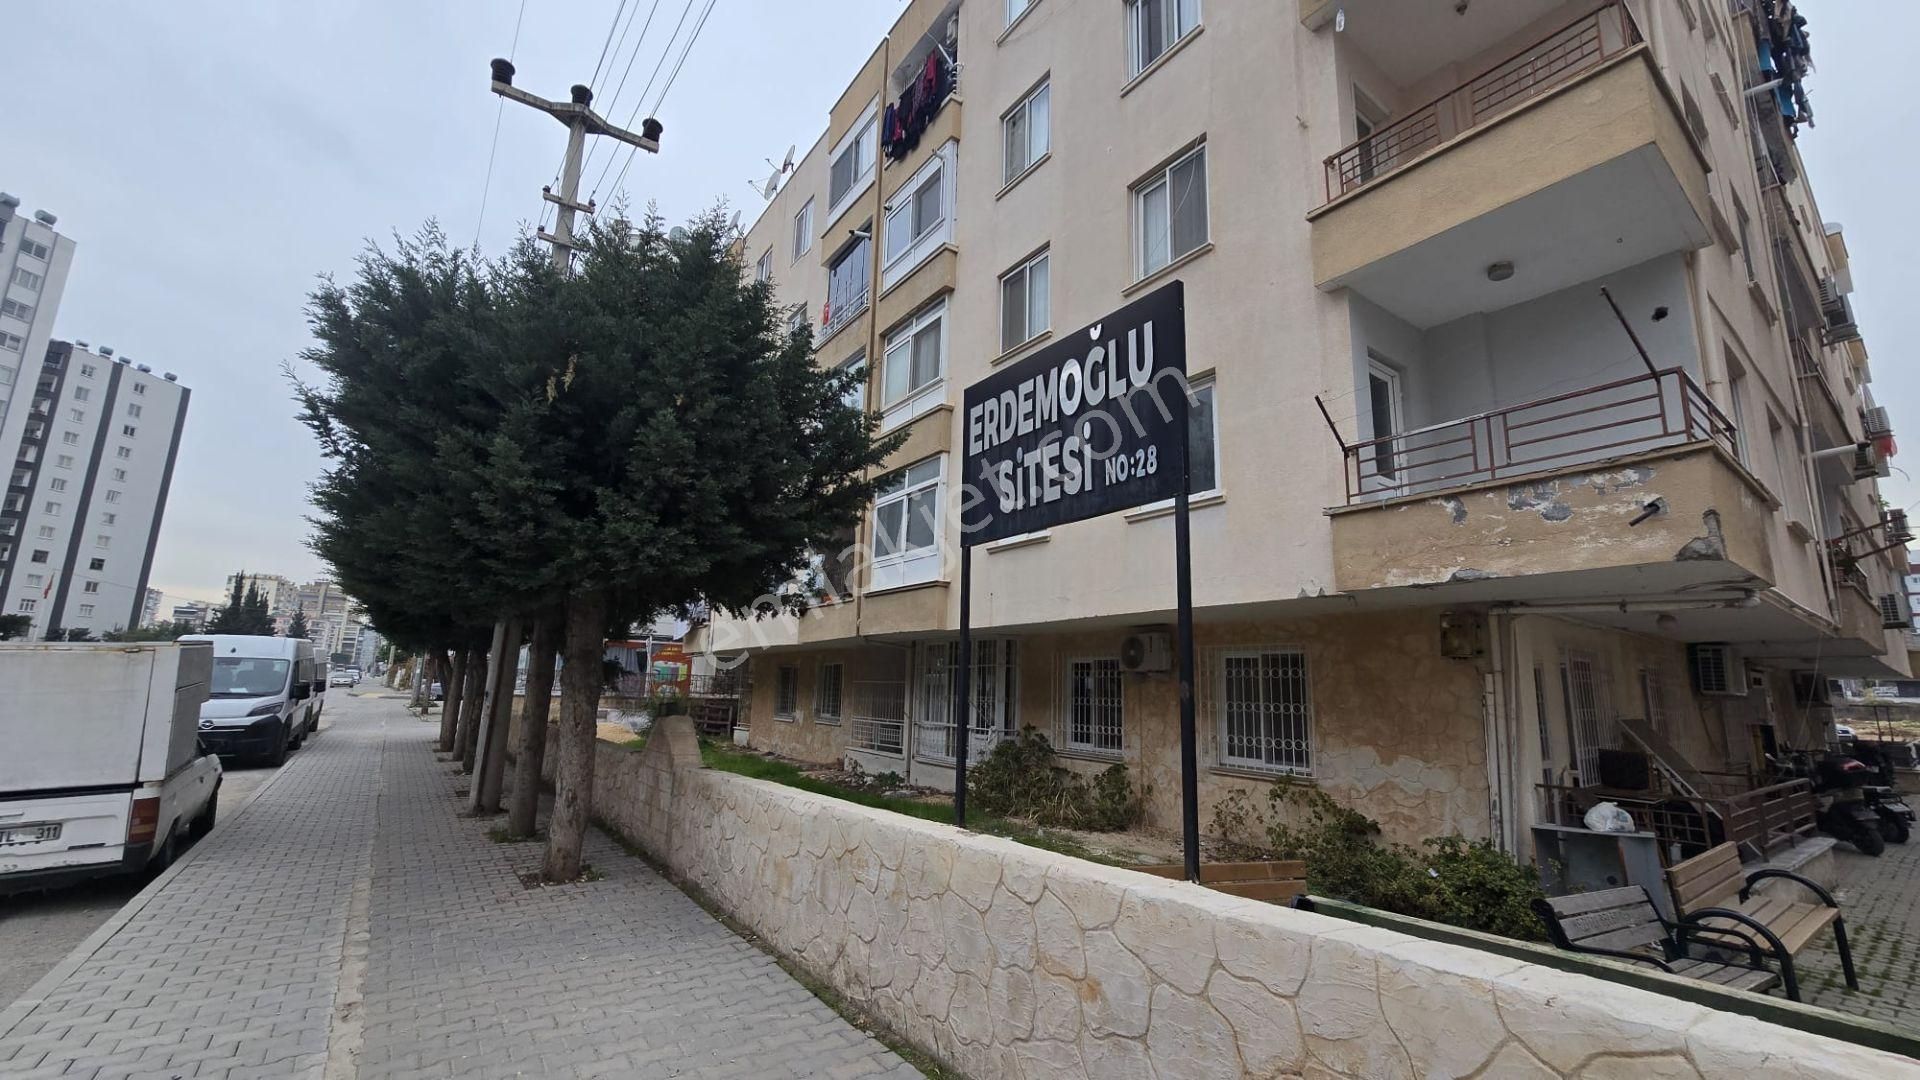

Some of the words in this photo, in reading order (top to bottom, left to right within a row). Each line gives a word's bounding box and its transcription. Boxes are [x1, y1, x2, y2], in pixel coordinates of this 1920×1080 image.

[969, 320, 1154, 456] ERDEMOĞLU
[1105, 444, 1158, 485] NO:28
[36, 826, 58, 839] 311
